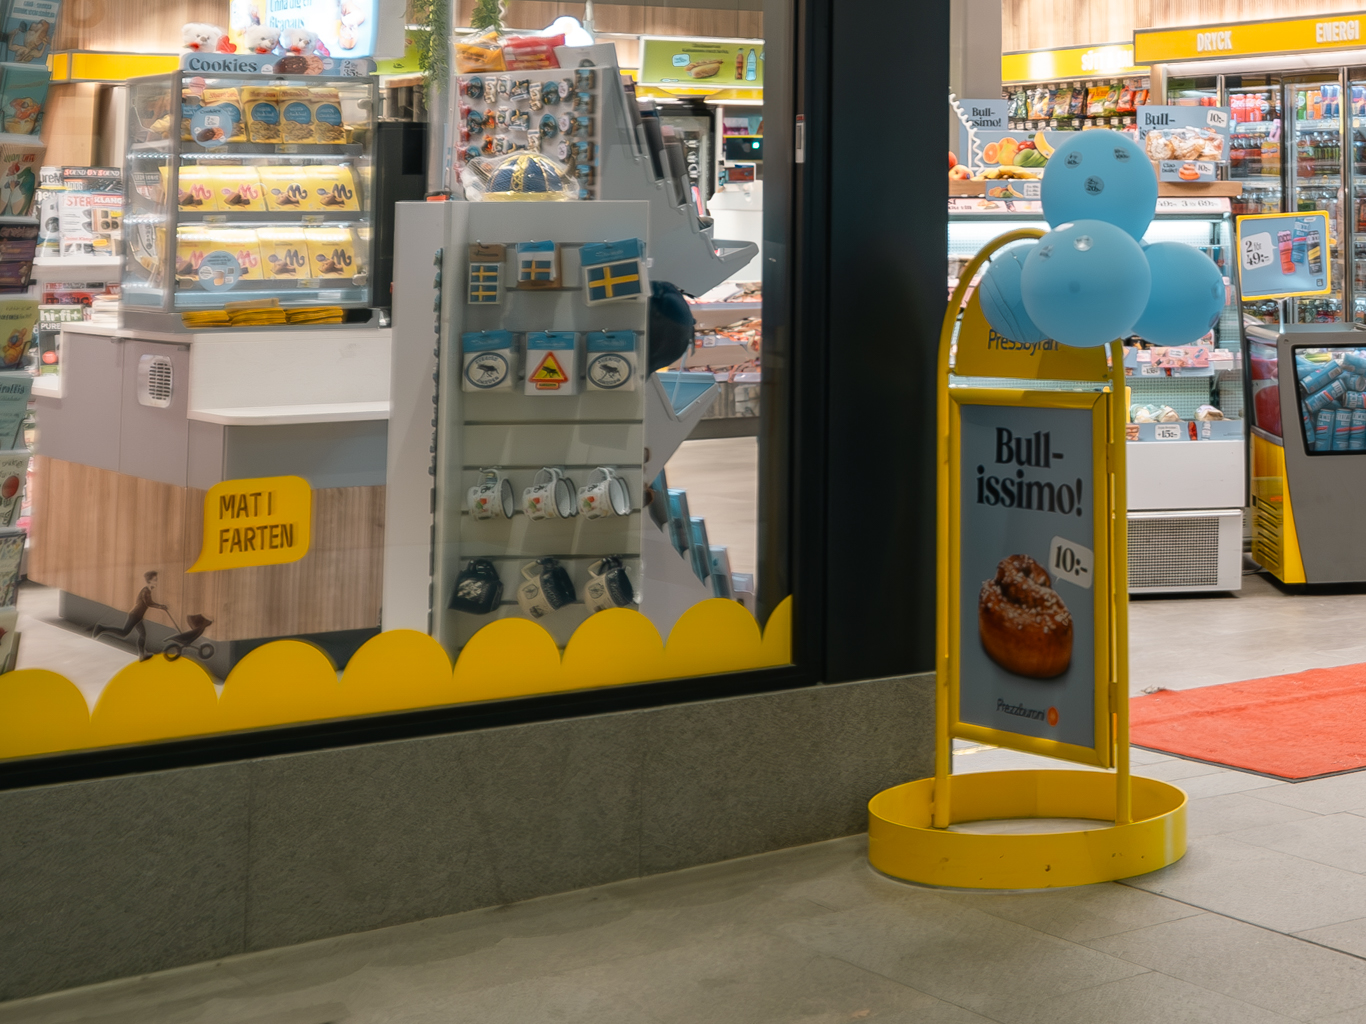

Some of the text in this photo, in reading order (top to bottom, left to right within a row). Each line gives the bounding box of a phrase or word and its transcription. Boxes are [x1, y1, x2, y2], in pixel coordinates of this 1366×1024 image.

[1315, 19, 1360, 44] ENERGI
[1196, 31, 1233, 53] DRYCK
[188, 57, 258, 74] Cookies
[344, 60, 351, 69] 2
[972, 107, 996, 117] Bull-
[1145, 112, 1176, 127] Bull-
[968, 117, 1002, 128] ssimo!
[1245, 240, 1254, 253] 2
[1246, 252, 1270, 266] 49:-
[40, 309, 81, 322] hi-fi+
[40, 322, 61, 331] PURE
[995, 427, 1064, 469] Bull-
[976, 464, 1083, 518] issimo!
[219, 491, 272, 520] MAT I
[218, 522, 294, 555] FARTEN
[1054, 544, 1088, 576] 10:-
[996, 697, 1046, 722] Prezzburoni
